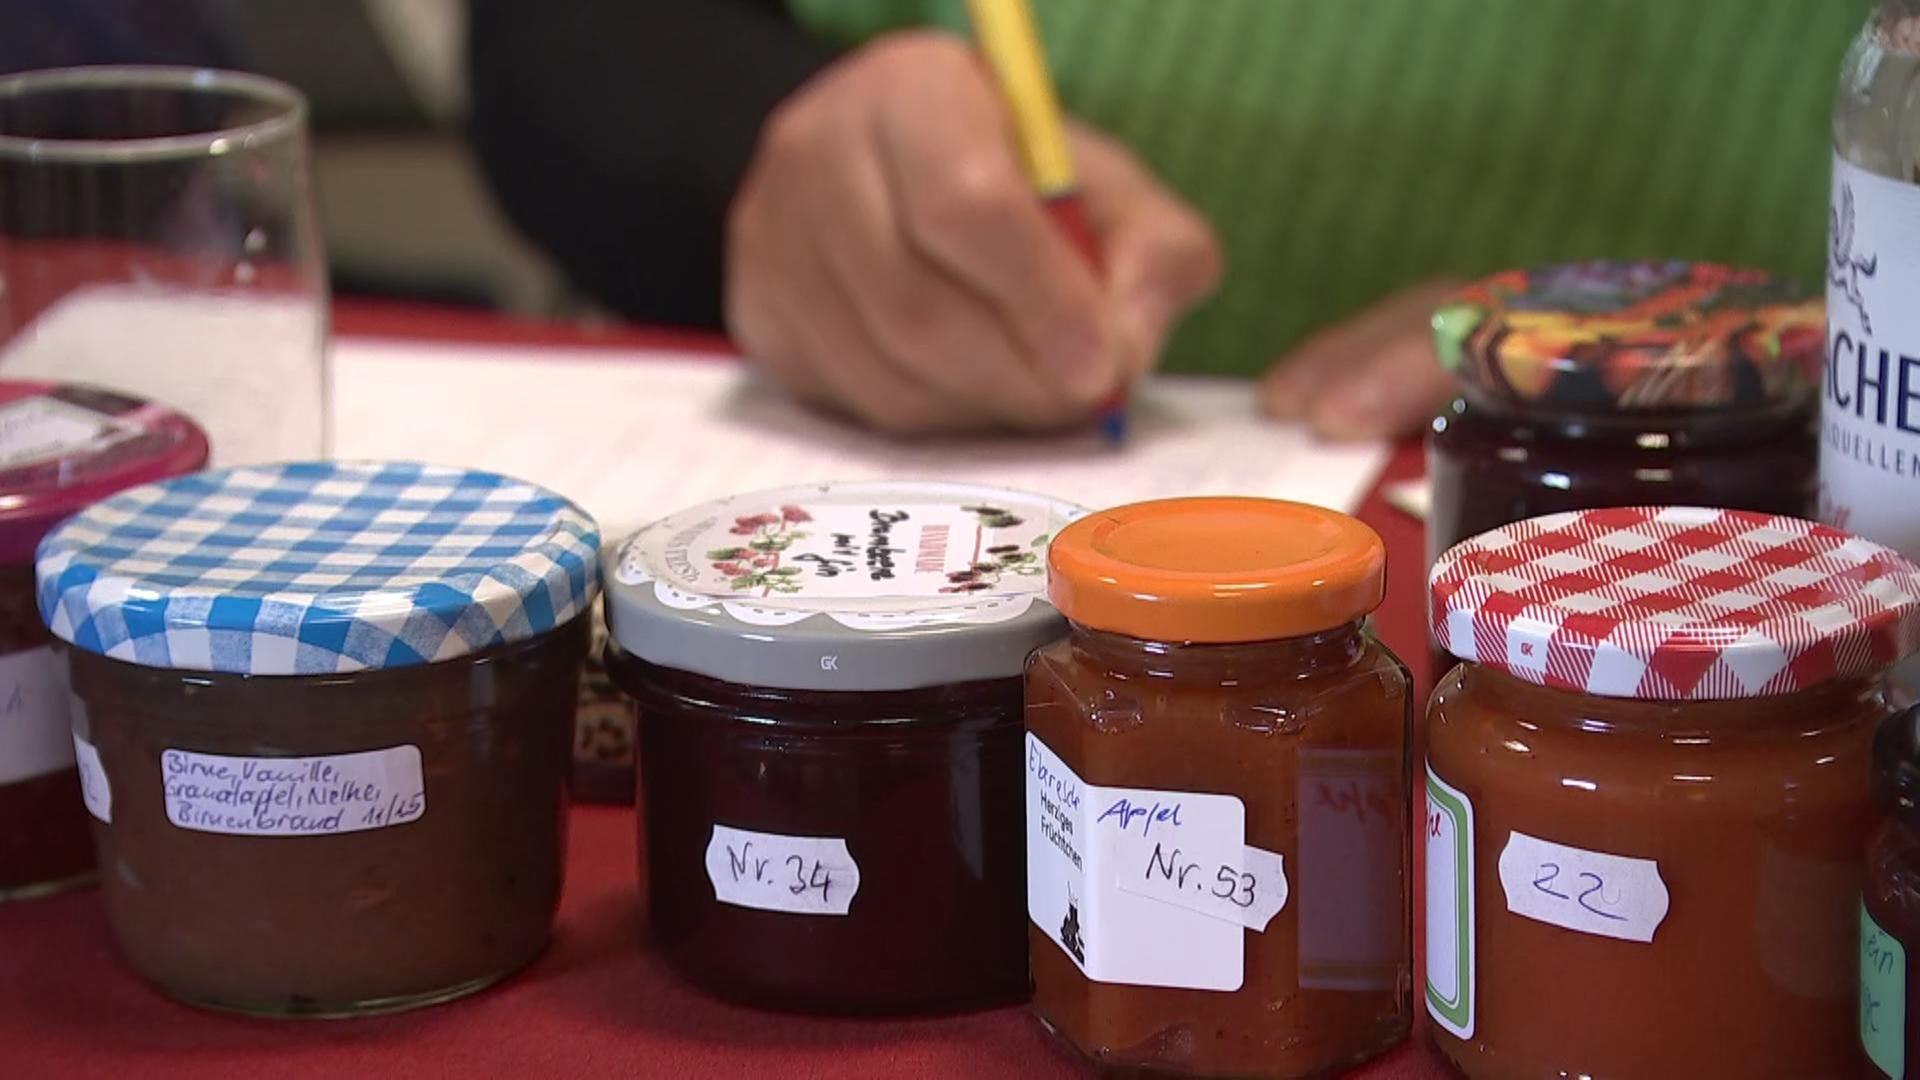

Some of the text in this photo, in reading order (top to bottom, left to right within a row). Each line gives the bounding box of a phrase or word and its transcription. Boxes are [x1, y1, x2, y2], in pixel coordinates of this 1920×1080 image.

[820, 655, 838, 670] GK
[1040, 791, 1074, 836] Herziges
[727, 841, 832, 902] Nr. 34
[1040, 815, 1083, 872] Früchtchen
[1146, 843, 1256, 908] Nr. 53
[1533, 862, 1629, 921] 22
